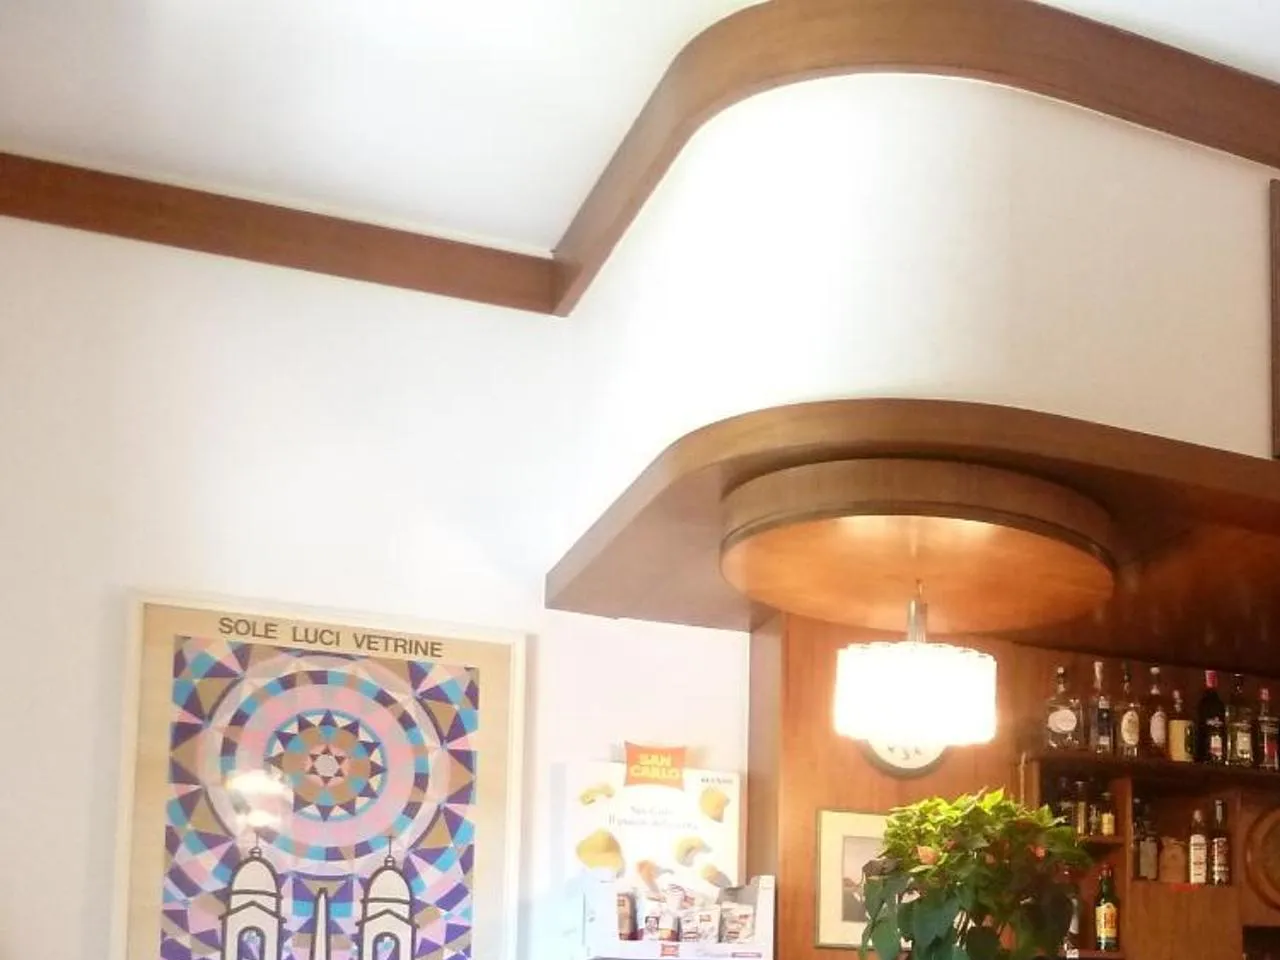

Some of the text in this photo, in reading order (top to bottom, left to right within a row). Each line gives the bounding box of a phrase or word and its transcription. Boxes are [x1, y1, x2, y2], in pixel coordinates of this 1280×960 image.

[219, 617, 443, 657] SOLE LUCI VETRINE
[638, 752, 672, 766] SAN
[629, 764, 680, 780] CARLO
